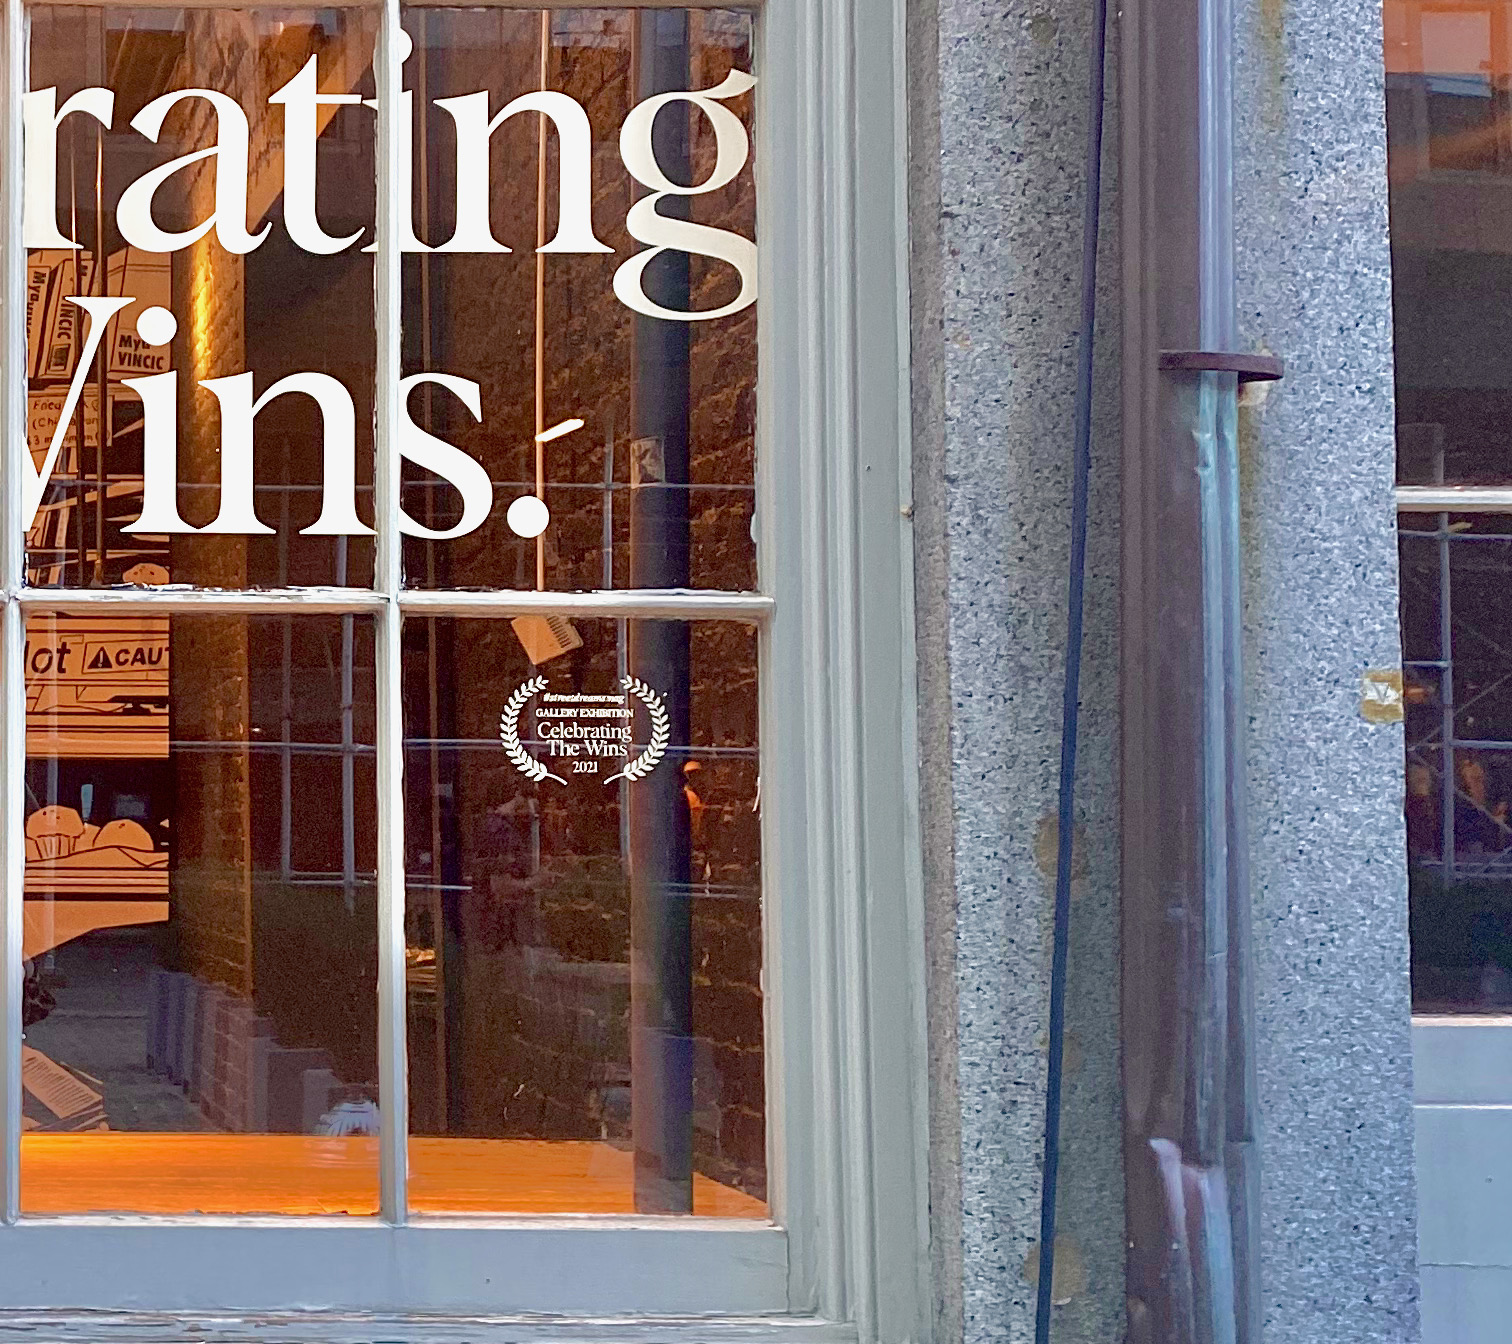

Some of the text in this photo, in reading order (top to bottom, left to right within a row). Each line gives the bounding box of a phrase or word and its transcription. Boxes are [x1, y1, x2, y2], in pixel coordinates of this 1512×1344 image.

[57, 300, 76, 340] INCIC
[118, 351, 164, 370] VINCIC
[115, 645, 170, 667] CAU
[536, 709, 634, 718] GALLERY EXHIBITION
[538, 722, 633, 743] Celebrating
[546, 740, 628, 756] The Wins
[572, 761, 599, 773] 2021
